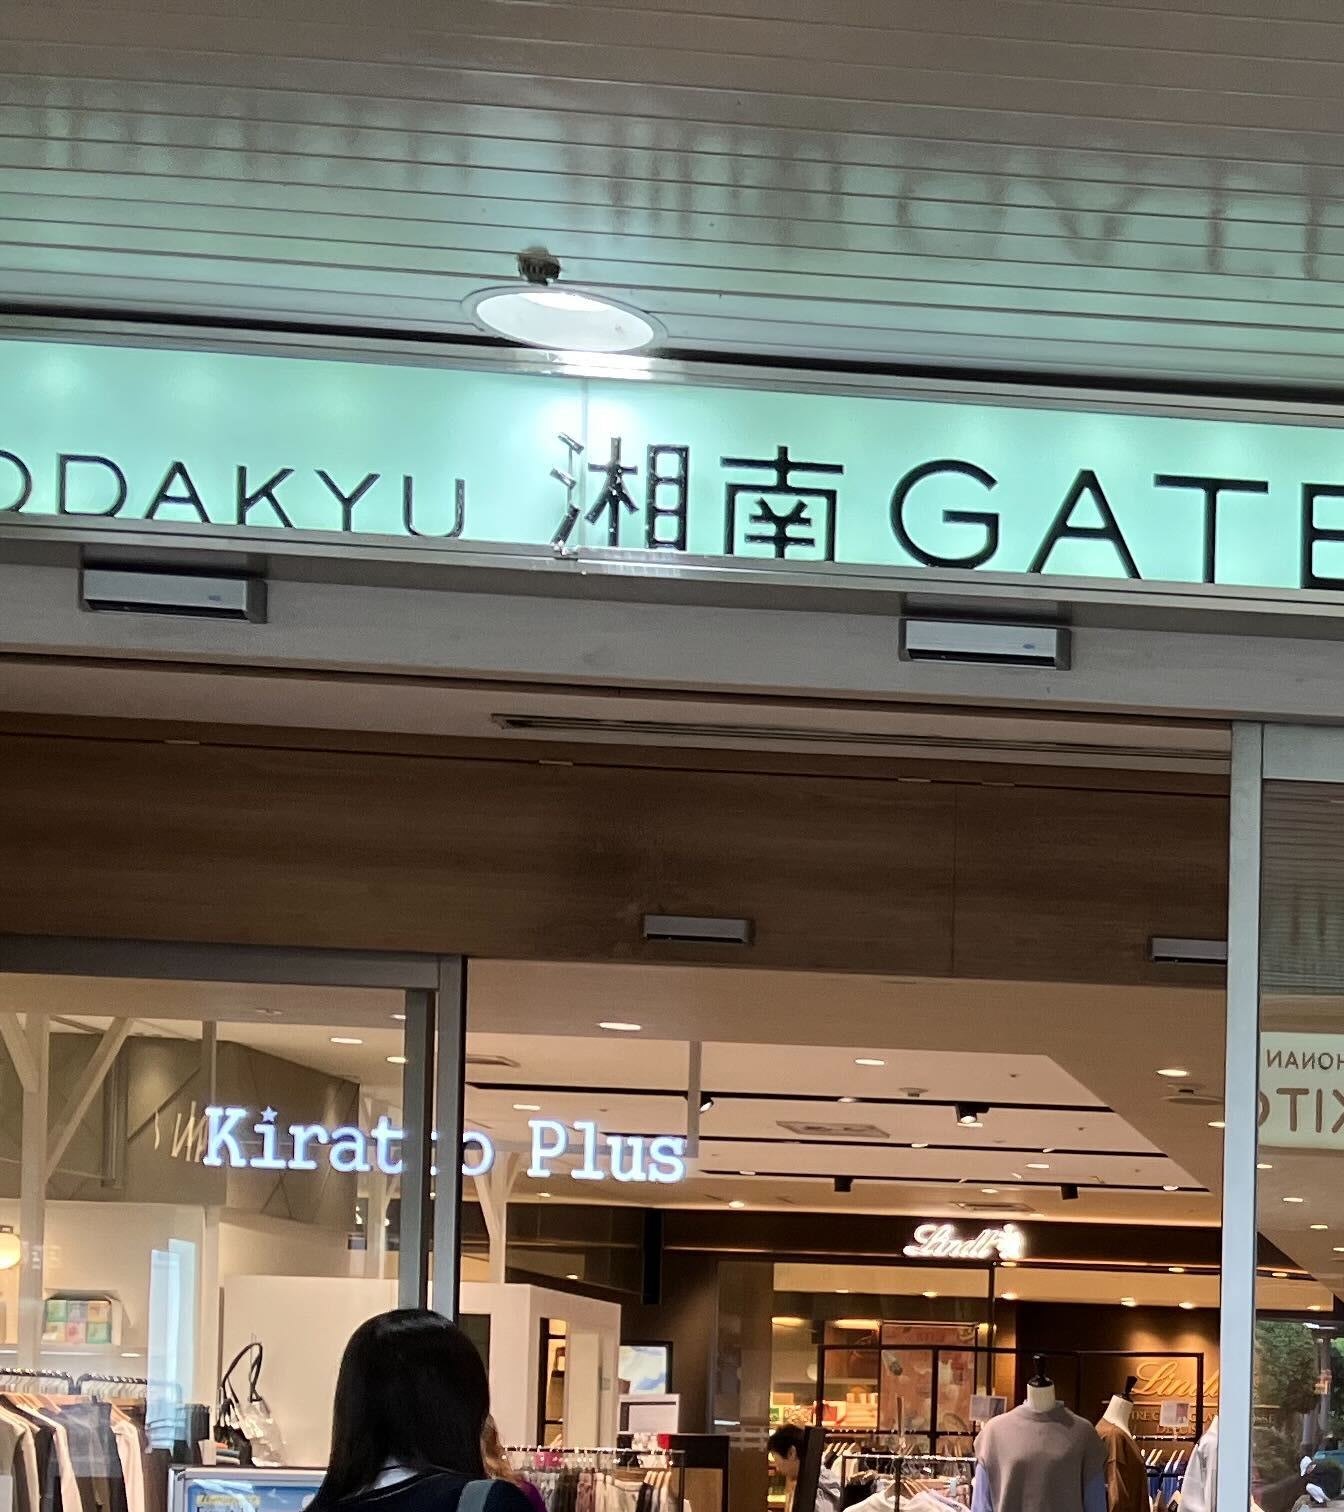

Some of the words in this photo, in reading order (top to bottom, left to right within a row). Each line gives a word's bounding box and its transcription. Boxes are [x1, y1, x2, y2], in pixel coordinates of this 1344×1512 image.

[204, 1106, 495, 1176] Kirato
[527, 1118, 686, 1183] Plus
[1131, 1361, 1219, 1398] Lind
